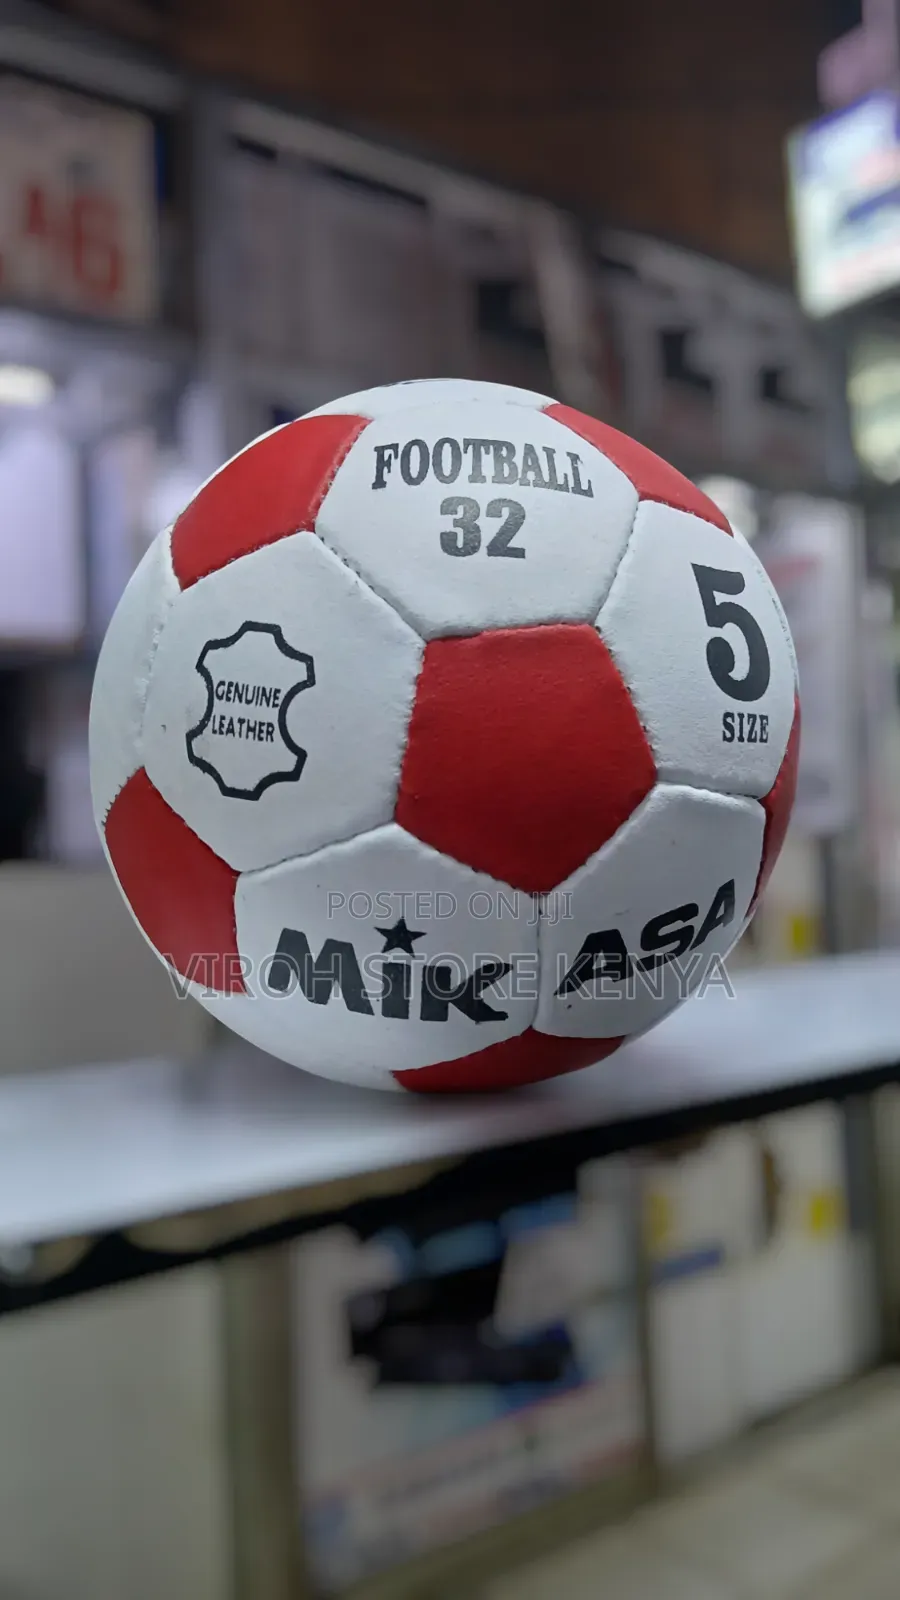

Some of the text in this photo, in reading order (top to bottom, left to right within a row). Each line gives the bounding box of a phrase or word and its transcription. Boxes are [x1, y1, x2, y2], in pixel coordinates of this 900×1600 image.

[371, 437, 594, 498] FOOTBALL
[439, 496, 526, 559] 32
[690, 562, 771, 702] 5
[215, 680, 281, 708] GENUINE
[211, 714, 275, 742] LEATHER
[722, 711, 769, 743] SIZE
[553, 878, 736, 997] ASA
